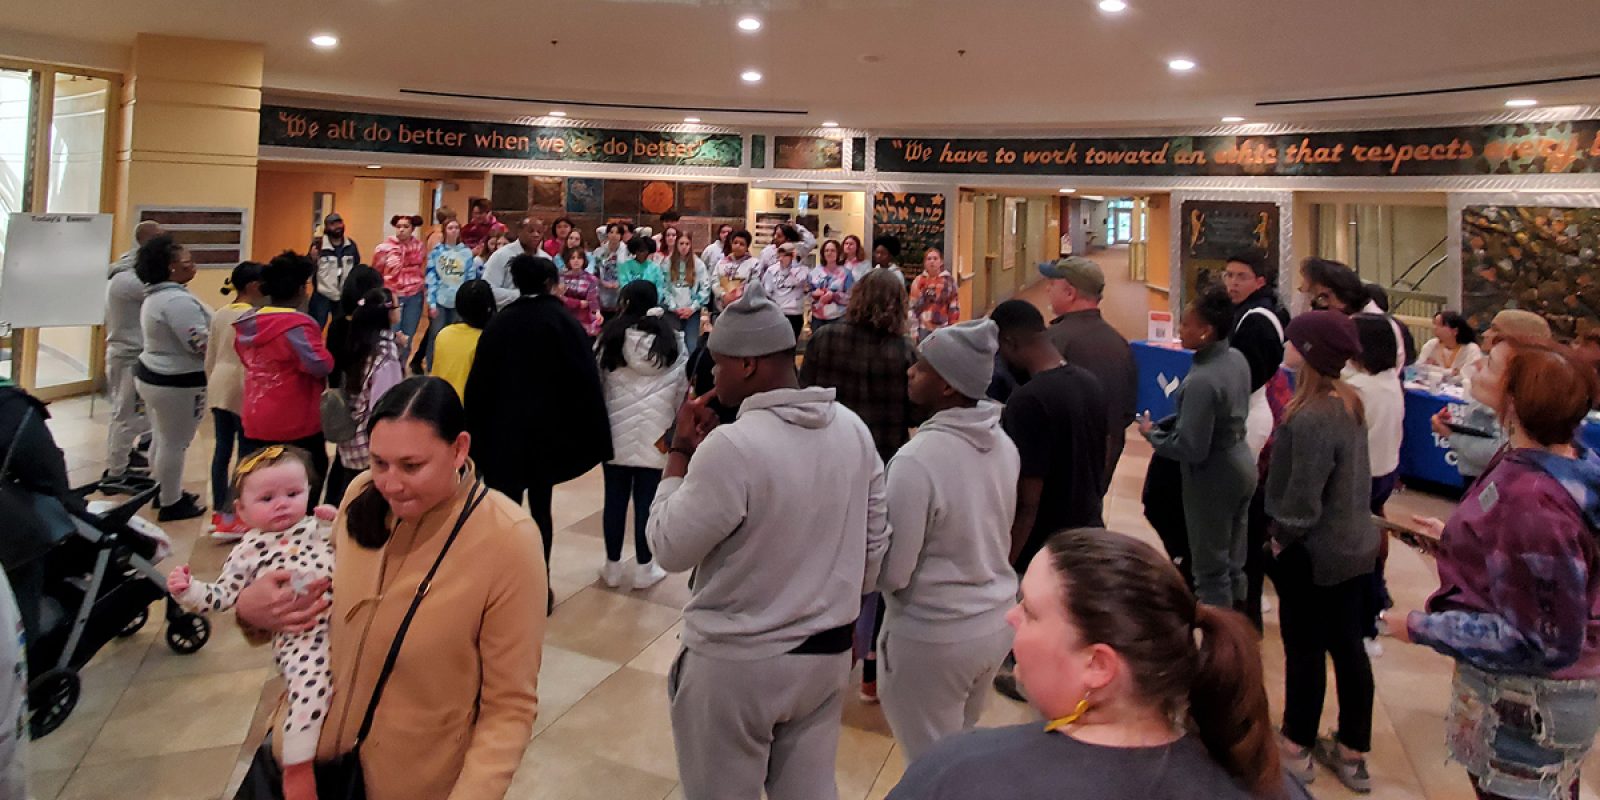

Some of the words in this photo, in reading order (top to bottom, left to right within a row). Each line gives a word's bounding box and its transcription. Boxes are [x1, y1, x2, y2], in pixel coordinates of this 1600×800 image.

[327, 119, 356, 141] all
[364, 122, 392, 142] do
[399, 123, 464, 148] better
[474, 129, 529, 151] when
[536, 136, 565, 153] we
[603, 137, 628, 156] do
[939, 142, 989, 164] have
[995, 147, 1017, 165] to
[1023, 142, 1077, 165] work
[1084, 142, 1168, 165] toward
[1173, 150, 1208, 165] an
[1286, 137, 1344, 165] that
[1352, 138, 1474, 175] respects
[1432, 431, 1450, 449] Te
